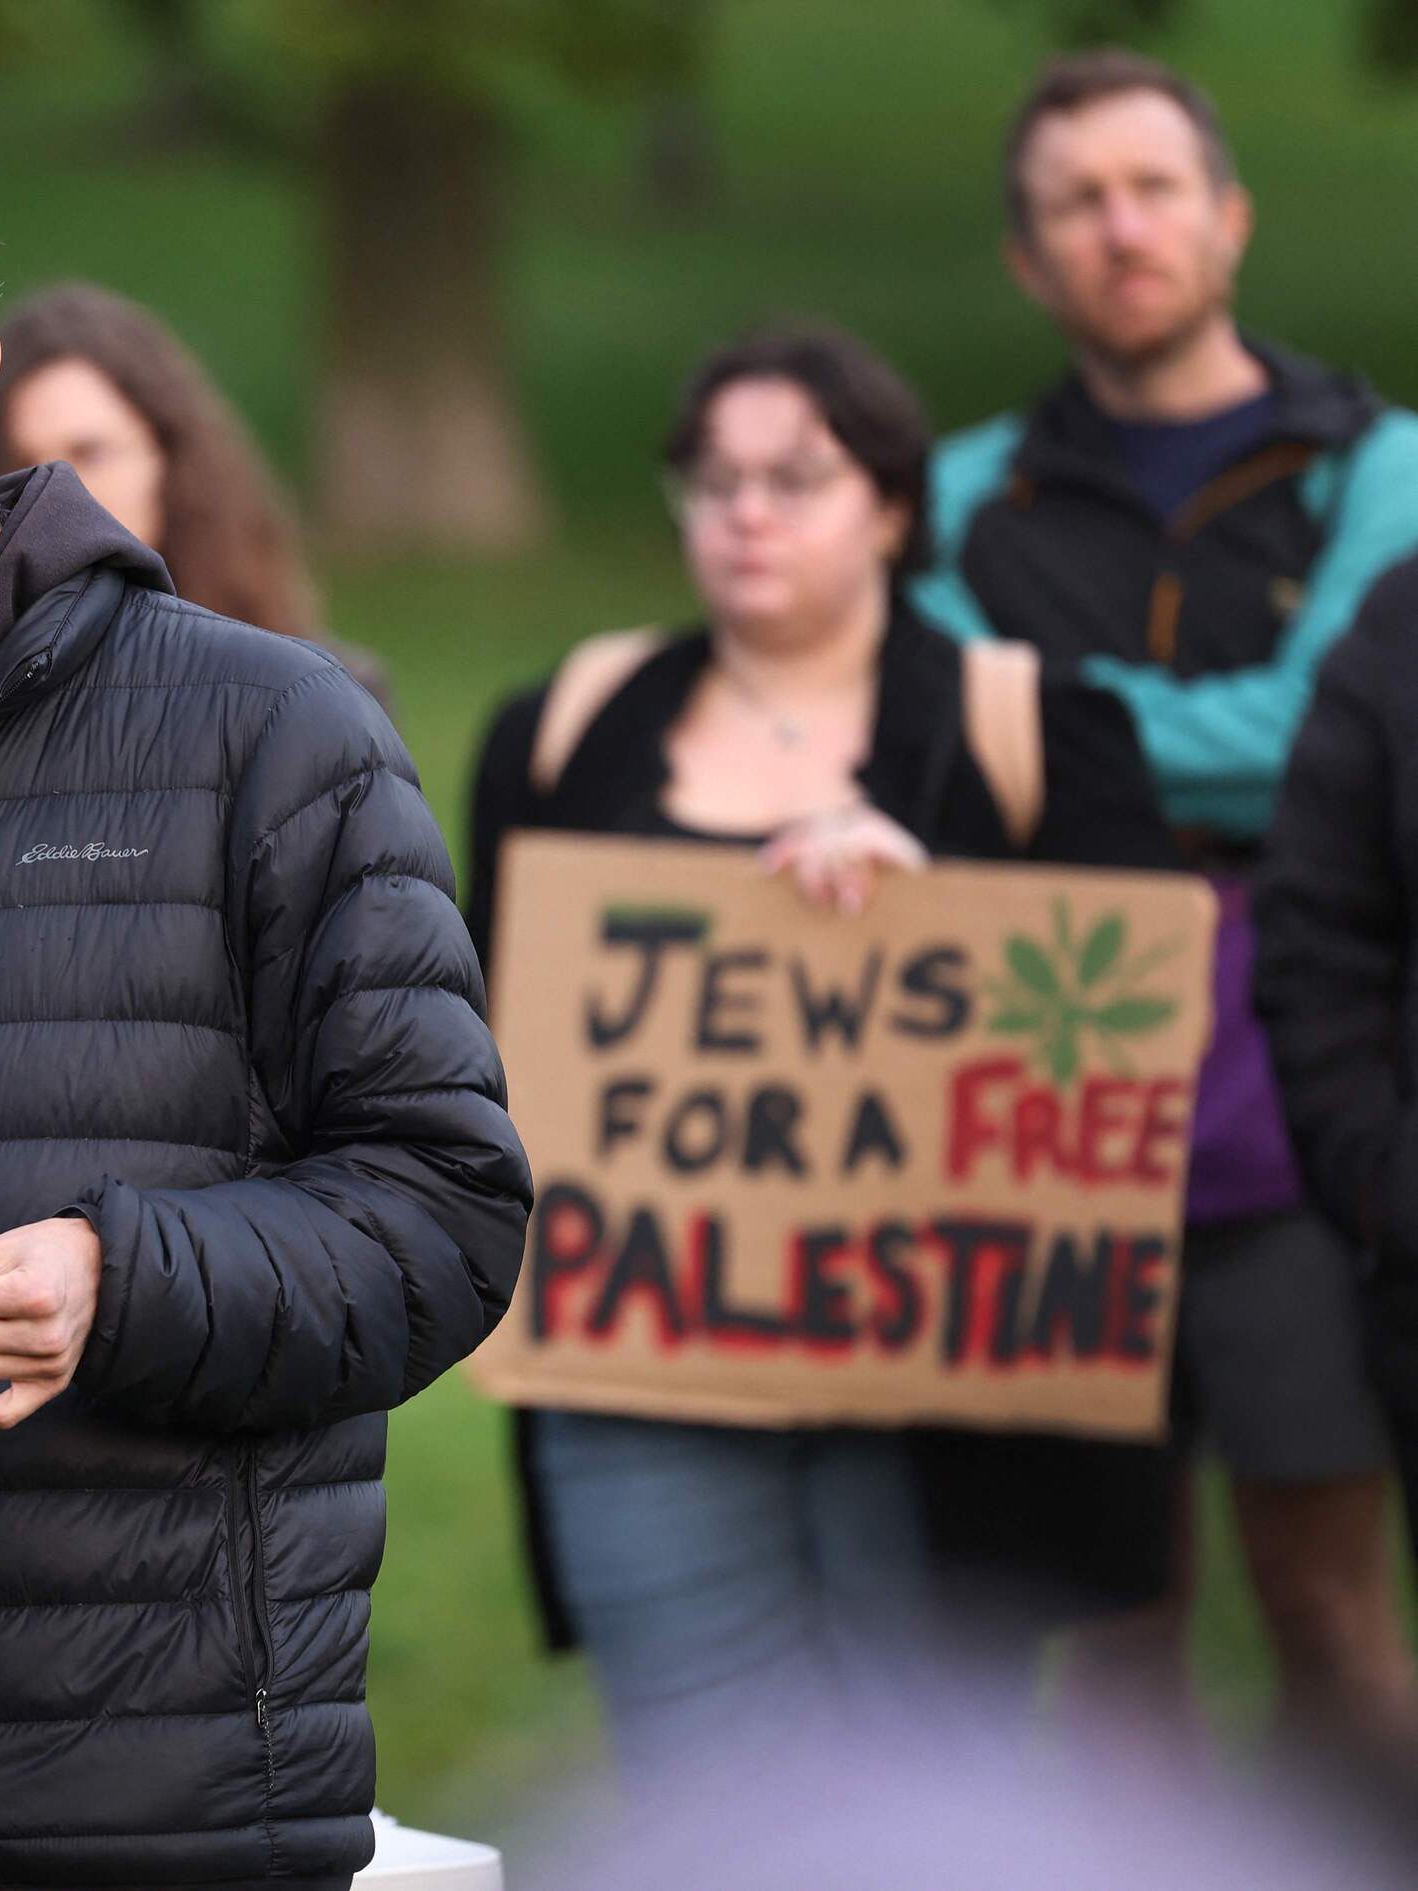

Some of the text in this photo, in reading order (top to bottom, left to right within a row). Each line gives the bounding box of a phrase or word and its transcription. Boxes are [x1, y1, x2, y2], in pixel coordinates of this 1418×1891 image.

[15, 842, 149, 866] Eddie Bauer
[587, 906, 977, 1058] JEWS
[595, 1054, 1188, 1186] FOR A FREE
[526, 1175, 1170, 1374] PALESTINE
